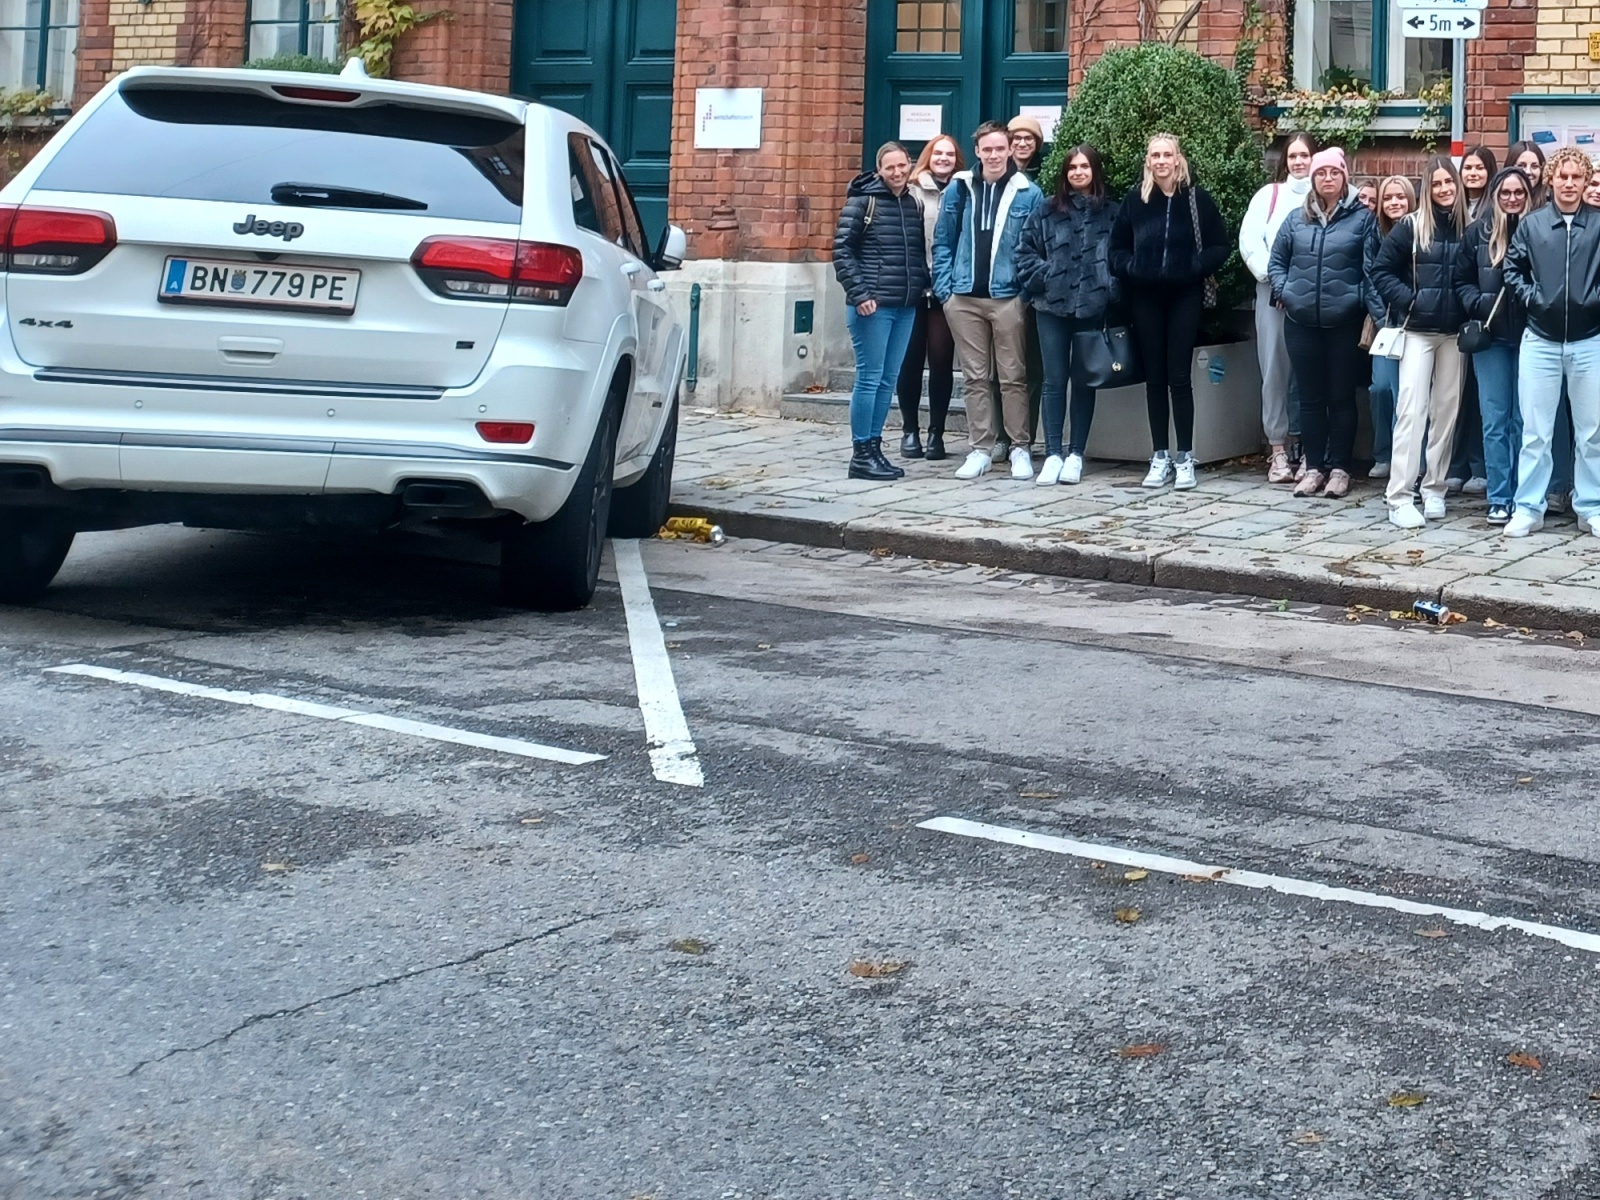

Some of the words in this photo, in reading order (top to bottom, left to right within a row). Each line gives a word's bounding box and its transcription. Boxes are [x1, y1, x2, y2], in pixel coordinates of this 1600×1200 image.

[1429, 14, 1452, 32] 5m
[233, 214, 304, 242] Jeep
[170, 281, 178, 290] A
[190, 266, 229, 293] BN
[251, 270, 305, 298] 779
[310, 274, 347, 301] PE
[19, 317, 73, 328] 4x4
